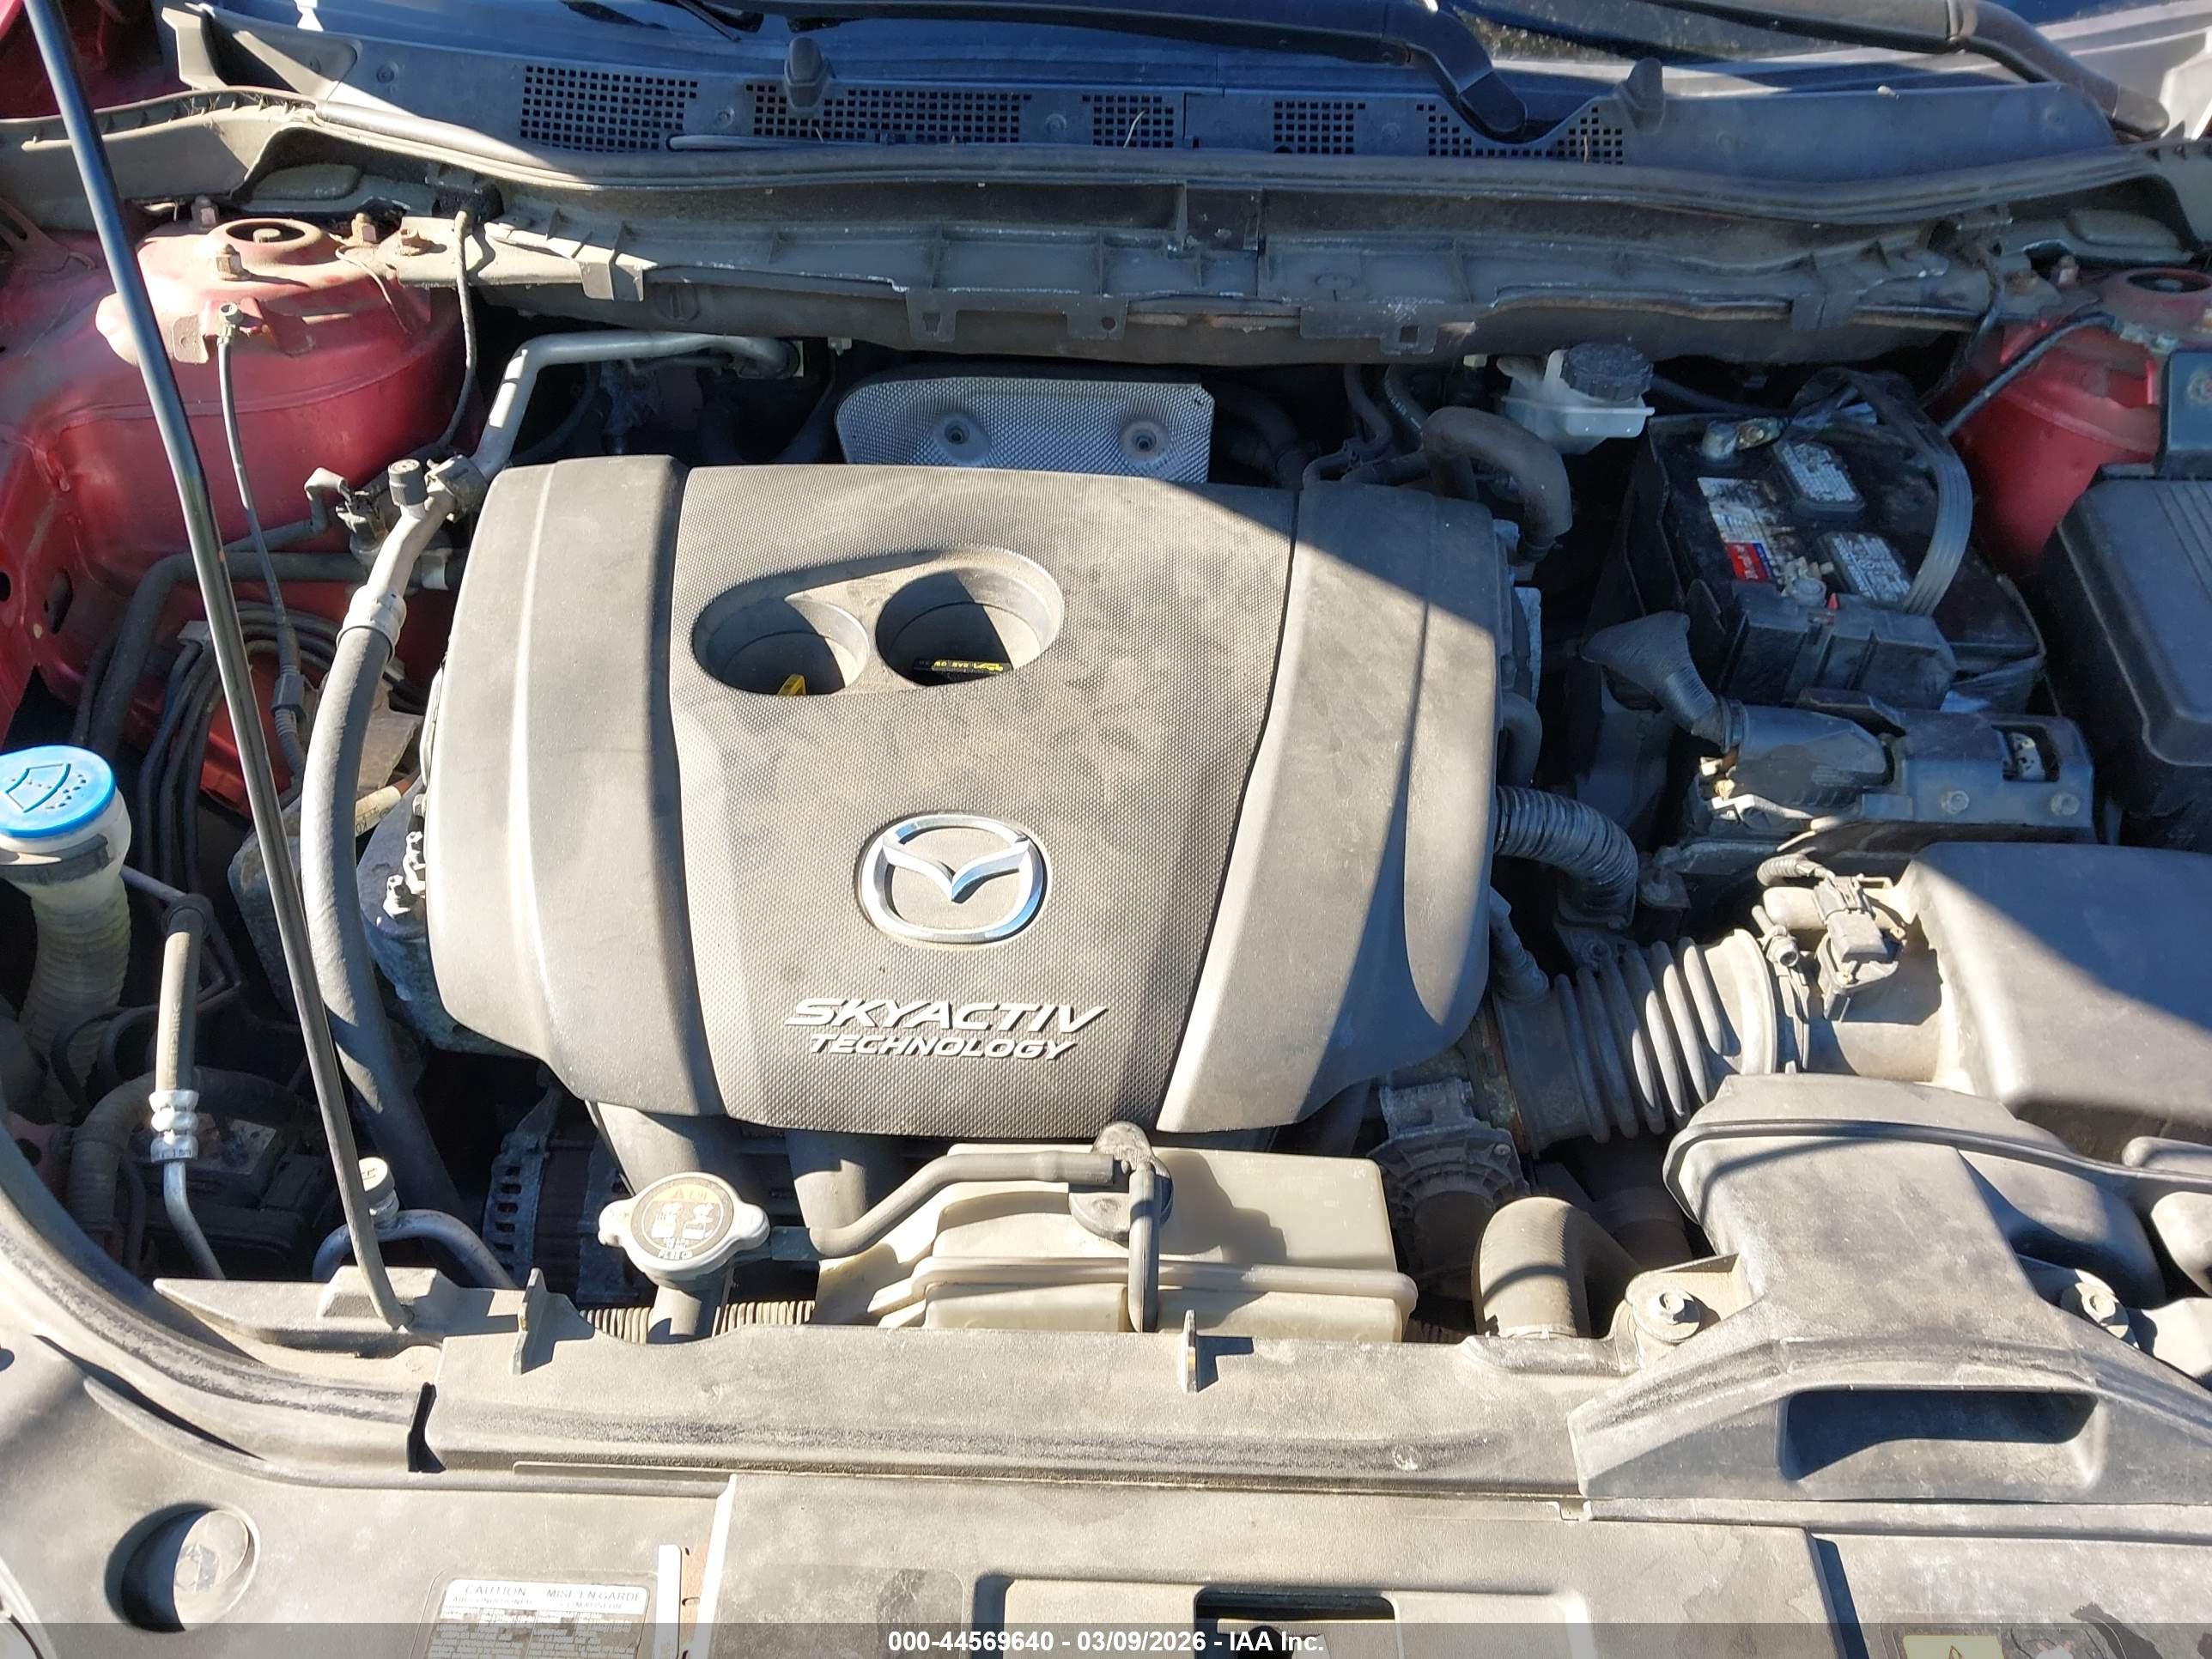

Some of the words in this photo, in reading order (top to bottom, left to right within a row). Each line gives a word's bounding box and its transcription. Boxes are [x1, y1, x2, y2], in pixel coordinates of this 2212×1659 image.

[784, 997, 1109, 1033] SKYACTIV
[810, 1034, 1078, 1060] TECHNOLOGY
[465, 1585, 527, 1596] CAUTION
[599, 1591, 641, 1601] GARDE
